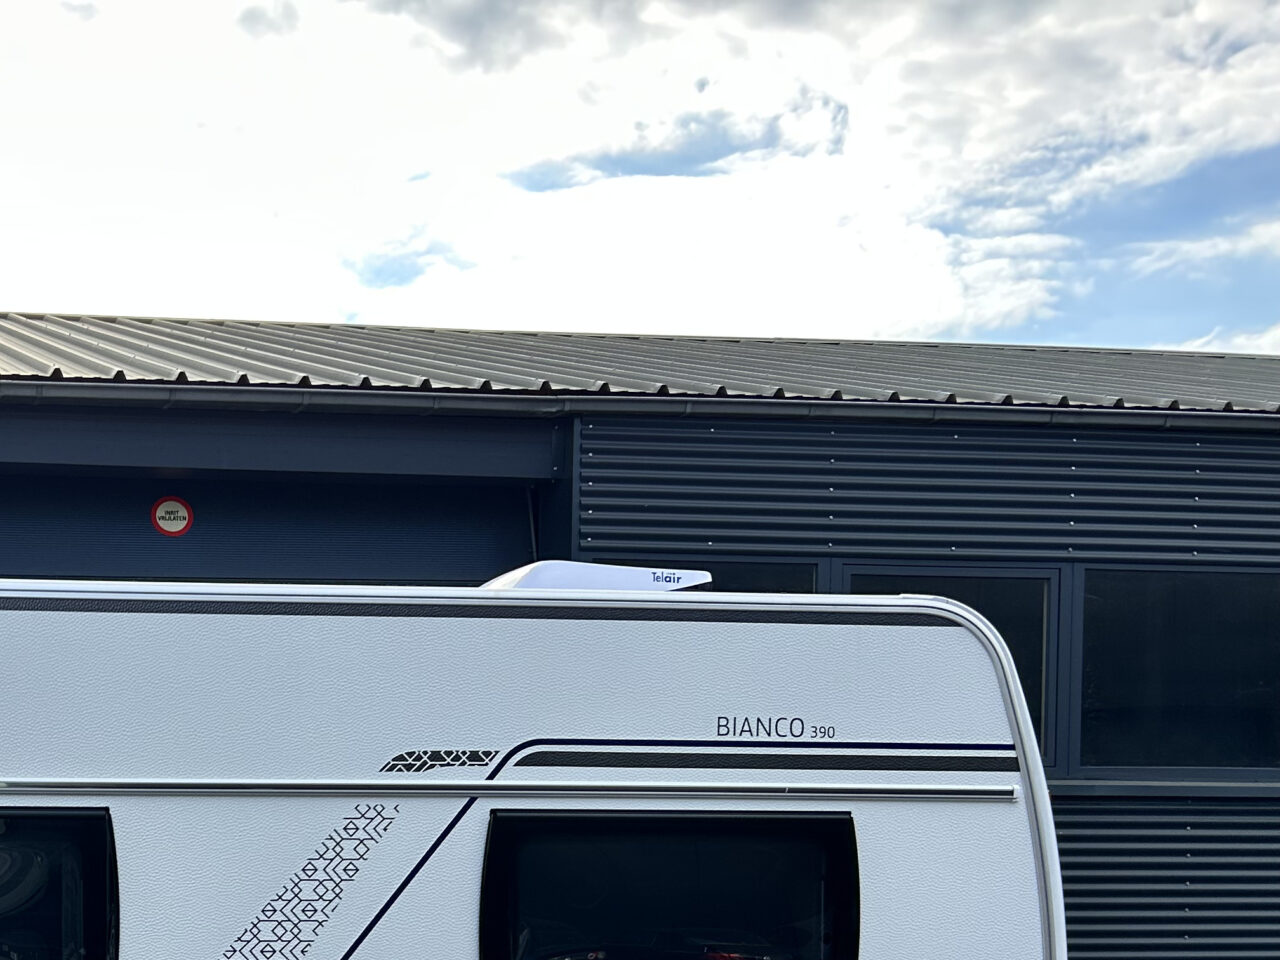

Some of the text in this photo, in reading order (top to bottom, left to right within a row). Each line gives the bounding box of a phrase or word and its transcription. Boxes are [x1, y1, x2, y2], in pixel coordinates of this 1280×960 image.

[651, 571, 682, 584] Telair
[717, 716, 836, 739] BIANCO 390
